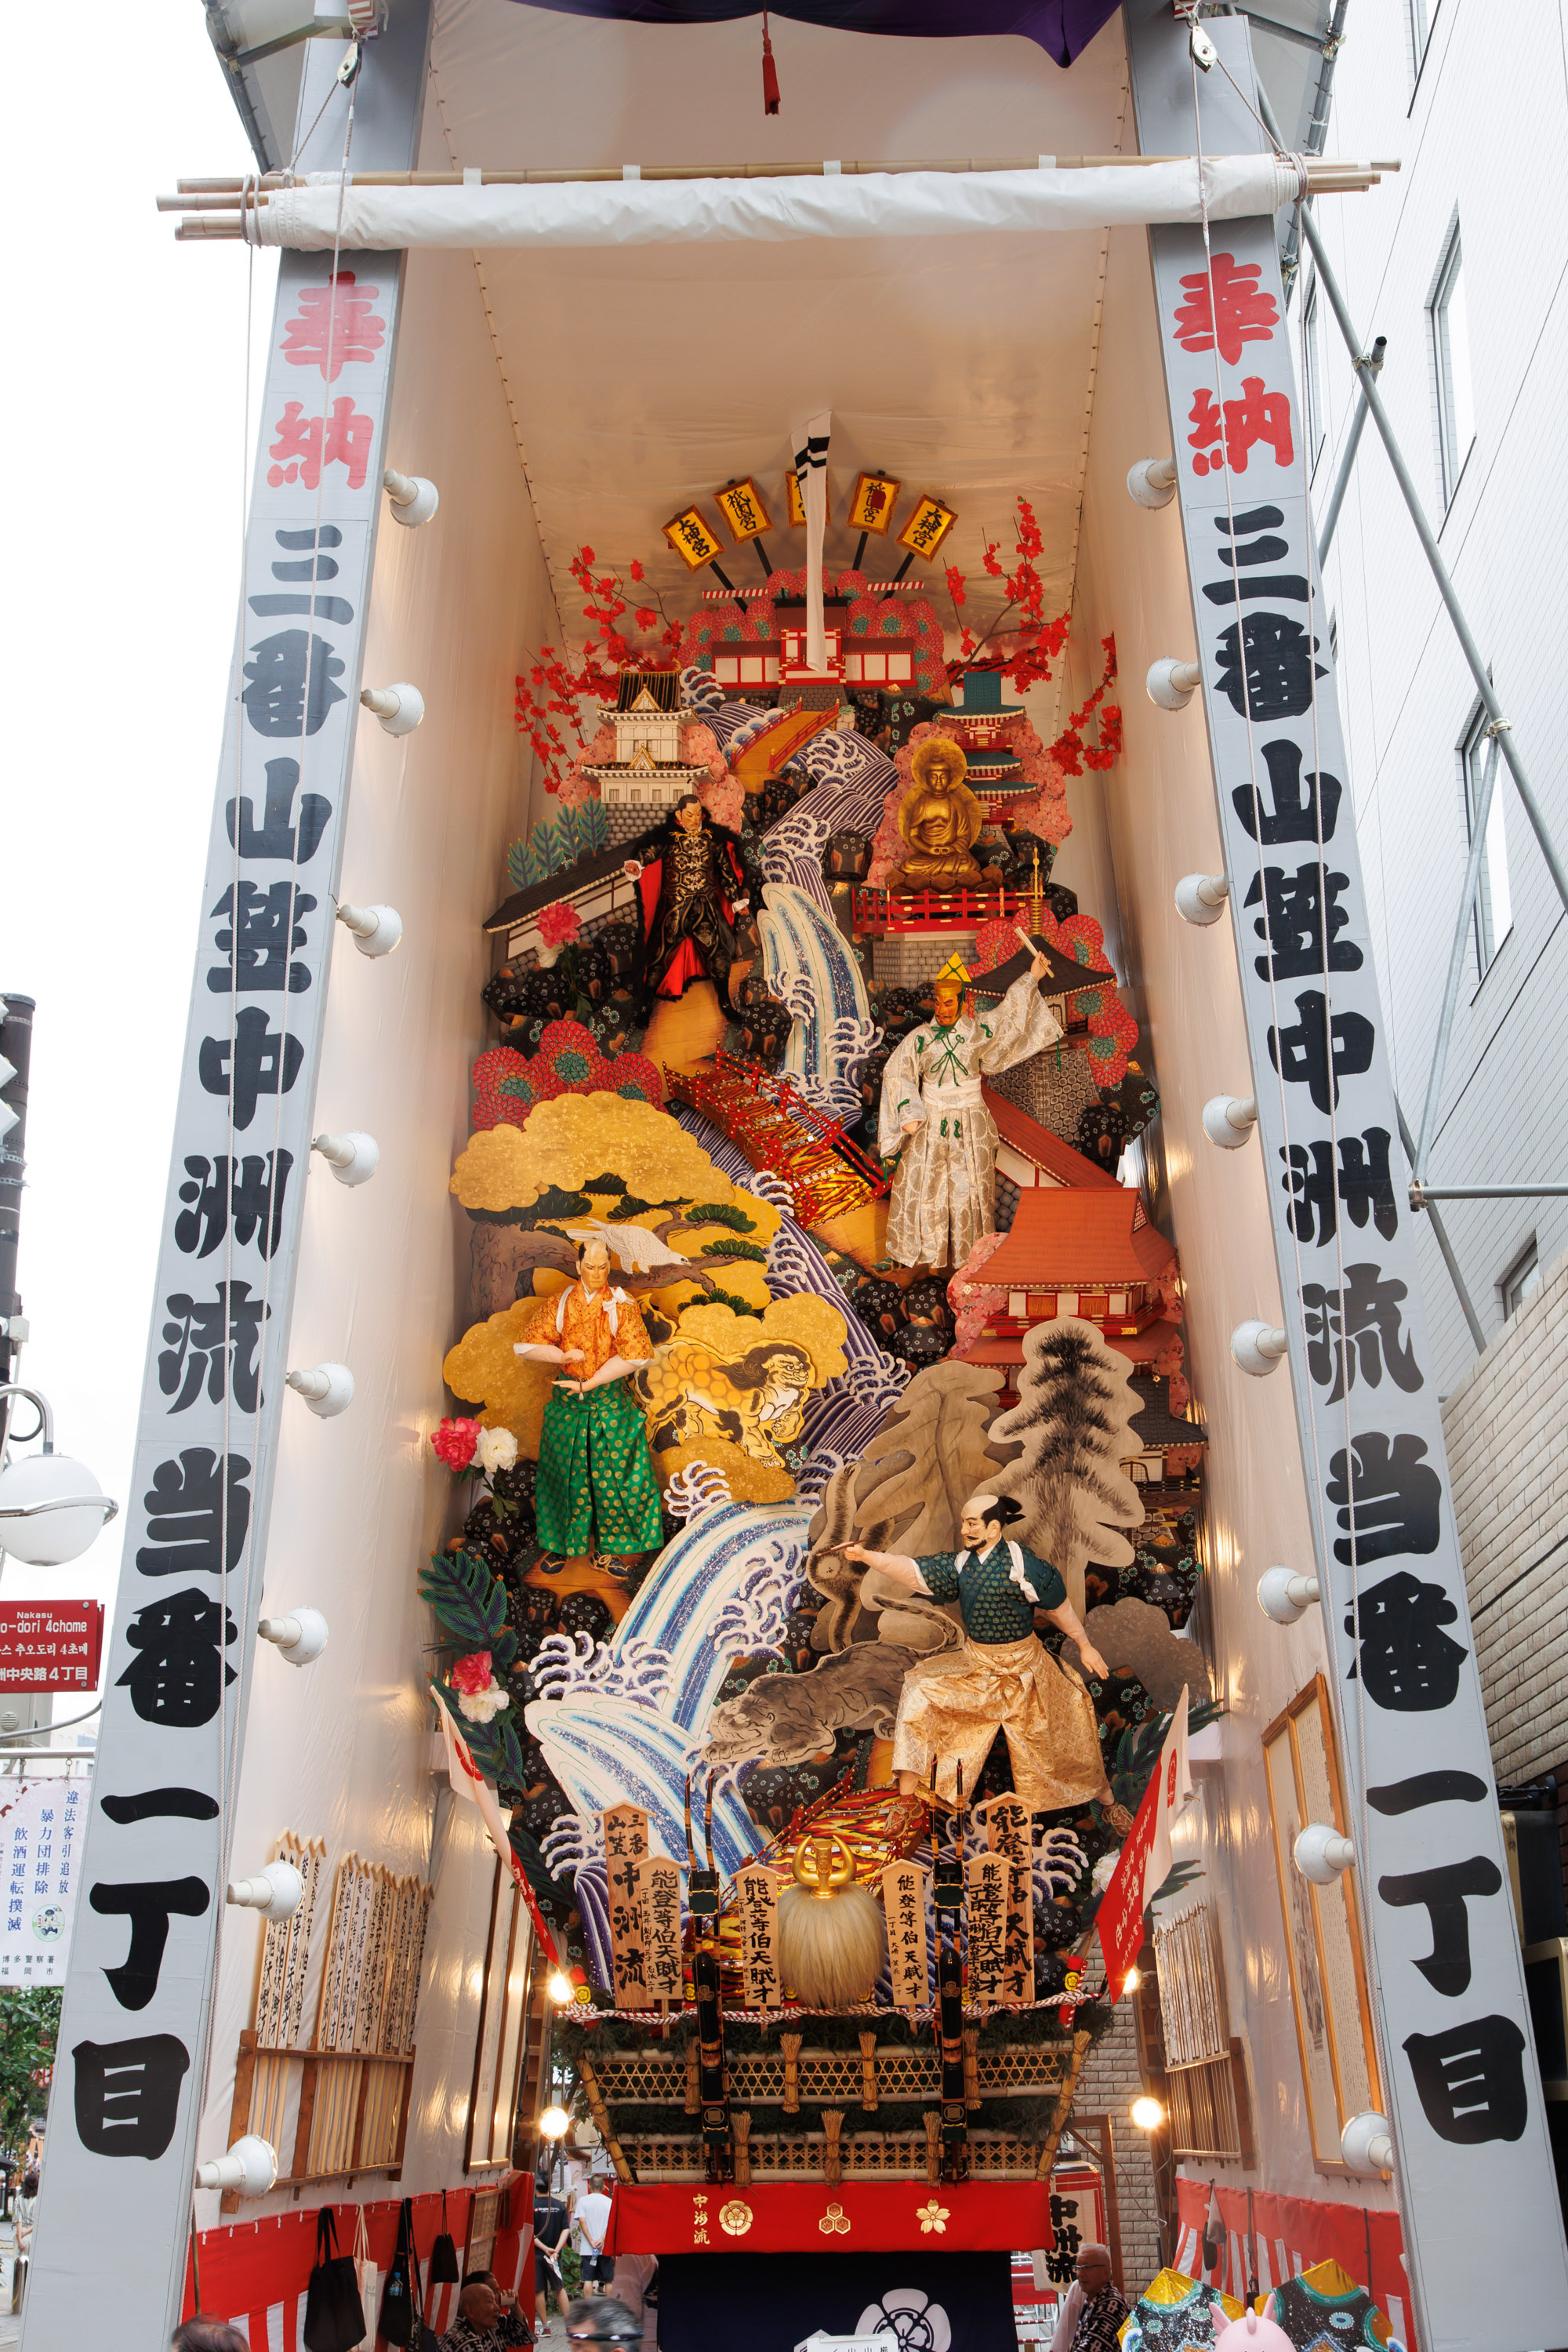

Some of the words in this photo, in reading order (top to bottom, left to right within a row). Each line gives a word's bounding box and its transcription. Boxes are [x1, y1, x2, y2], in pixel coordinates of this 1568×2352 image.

[677, 517, 710, 557] 大神宮
[913, 507, 942, 550] 大神宮
[15, 1643, 56, 1657] 추오도리
[60, 1642, 88, 1656] 4초메
[45, 1619, 87, 1633] 4chome
[7, 1827, 28, 1931] 飲酒運転撲滅
[34, 1809, 54, 1894] 暴力団排除
[58, 1790, 79, 1894] 違法客引追放
[1, 1966, 54, 1976] 福岡市
[2, 1955, 55, 1965] 博多警察署
[650, 1869, 681, 1994] 能登等伯天賦才
[743, 1875, 777, 2004] 能登等伯天賦才
[897, 1875, 924, 1998] 能登等伯天賦才
[979, 1863, 1004, 1994] 能登等伯天賦才
